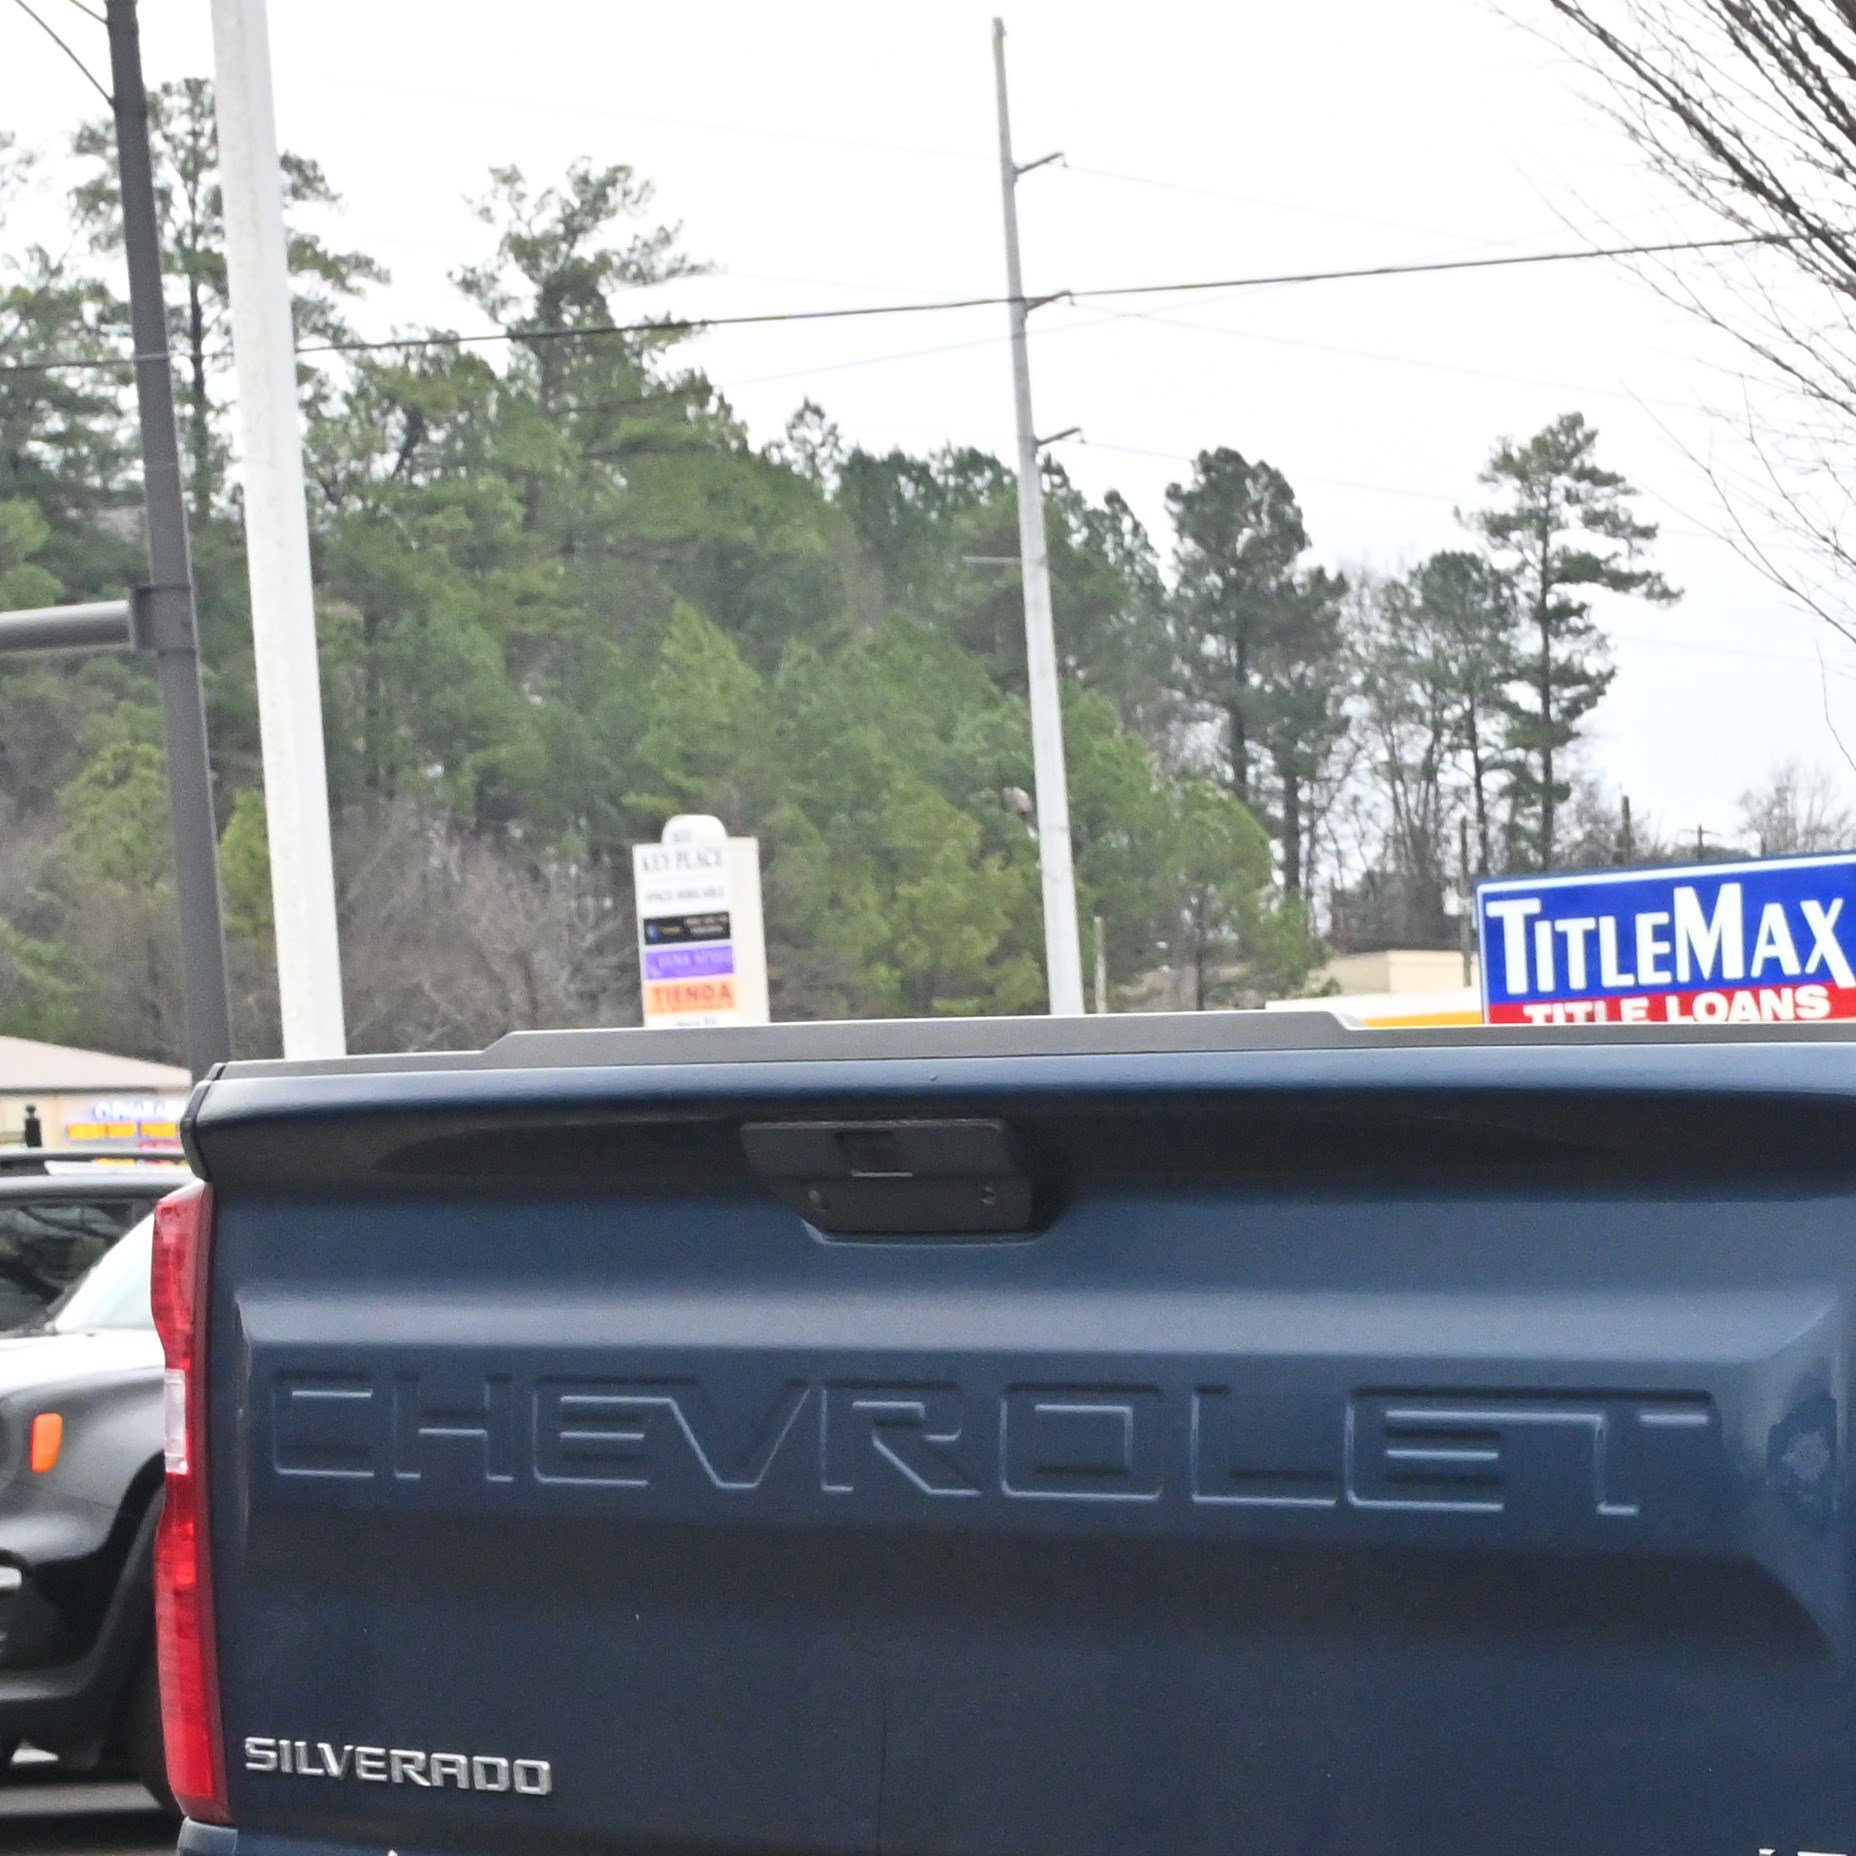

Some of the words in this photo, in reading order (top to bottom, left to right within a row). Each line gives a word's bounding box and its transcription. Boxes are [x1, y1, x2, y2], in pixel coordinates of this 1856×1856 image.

[1523, 997, 1650, 1023] TITLE
[1665, 984, 1832, 1022] LOANS
[272, 1373, 1714, 1516] CHEVROLET
[244, 1736, 551, 1795] SILVERADO
